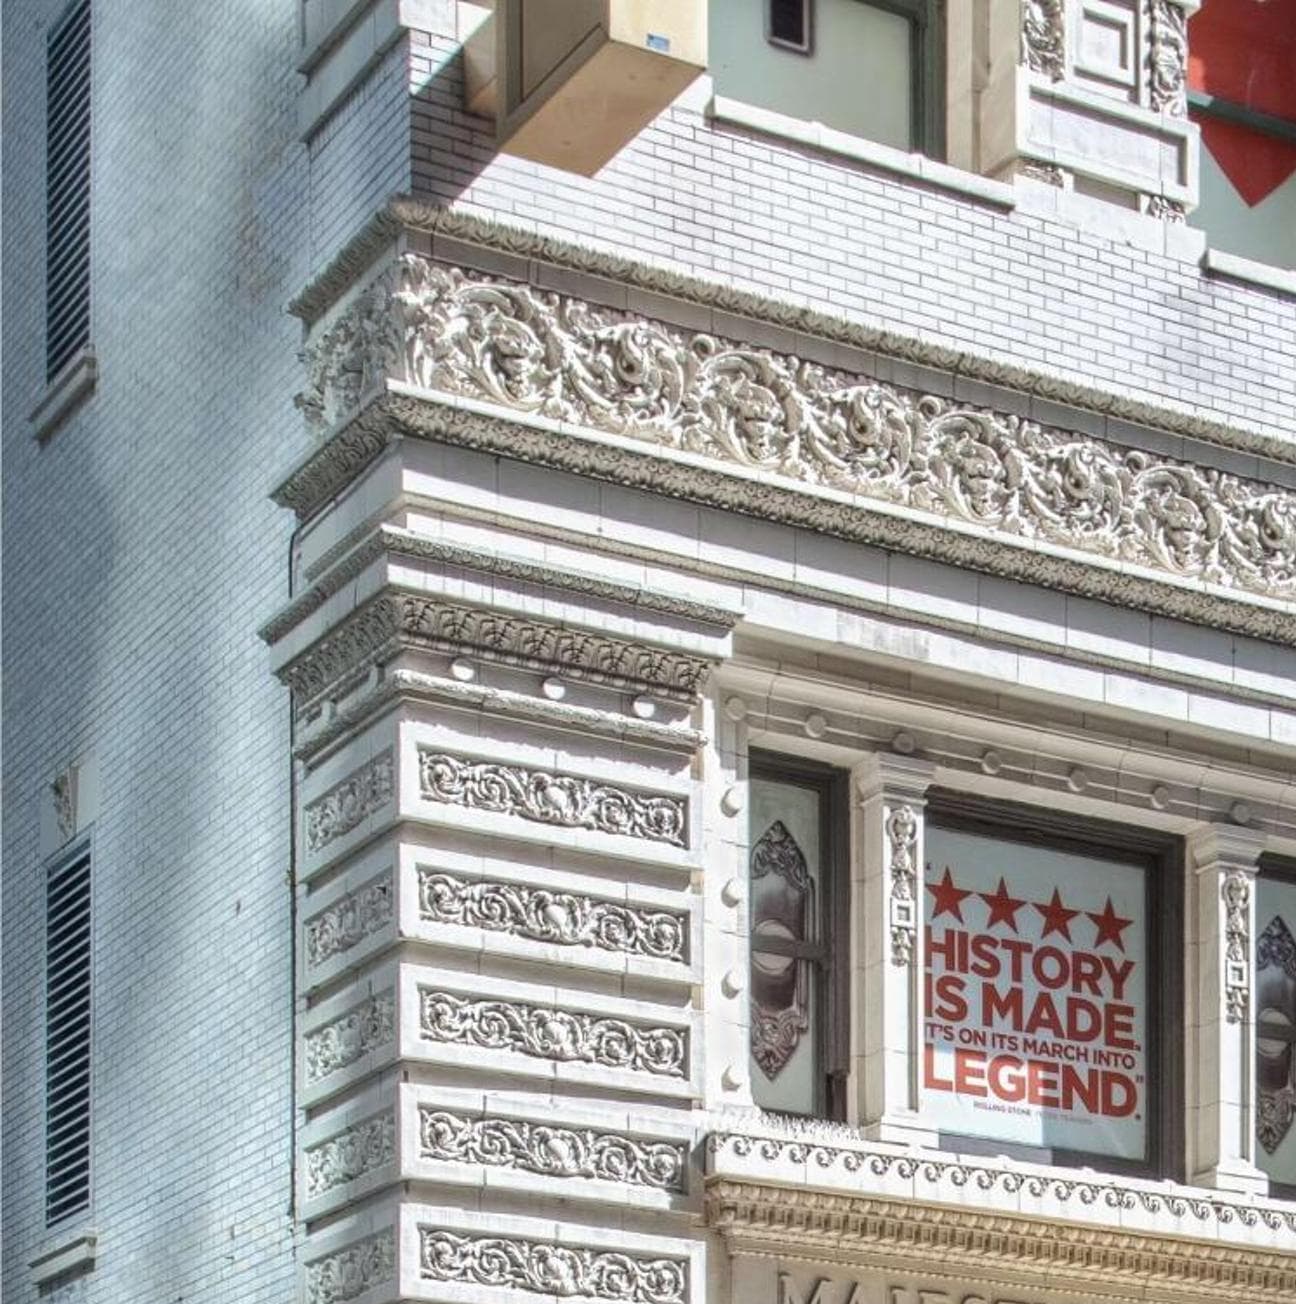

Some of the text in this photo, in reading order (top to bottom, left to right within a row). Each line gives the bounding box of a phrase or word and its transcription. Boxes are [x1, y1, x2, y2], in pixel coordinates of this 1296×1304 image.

[924, 925, 1135, 999] HISTORY
[924, 973, 968, 1023] IS
[959, 1028, 986, 1047] ON
[992, 1032, 1018, 1052] ITS
[1023, 1038, 1088, 1063] MARCH
[1093, 1049, 1135, 1070] INTO
